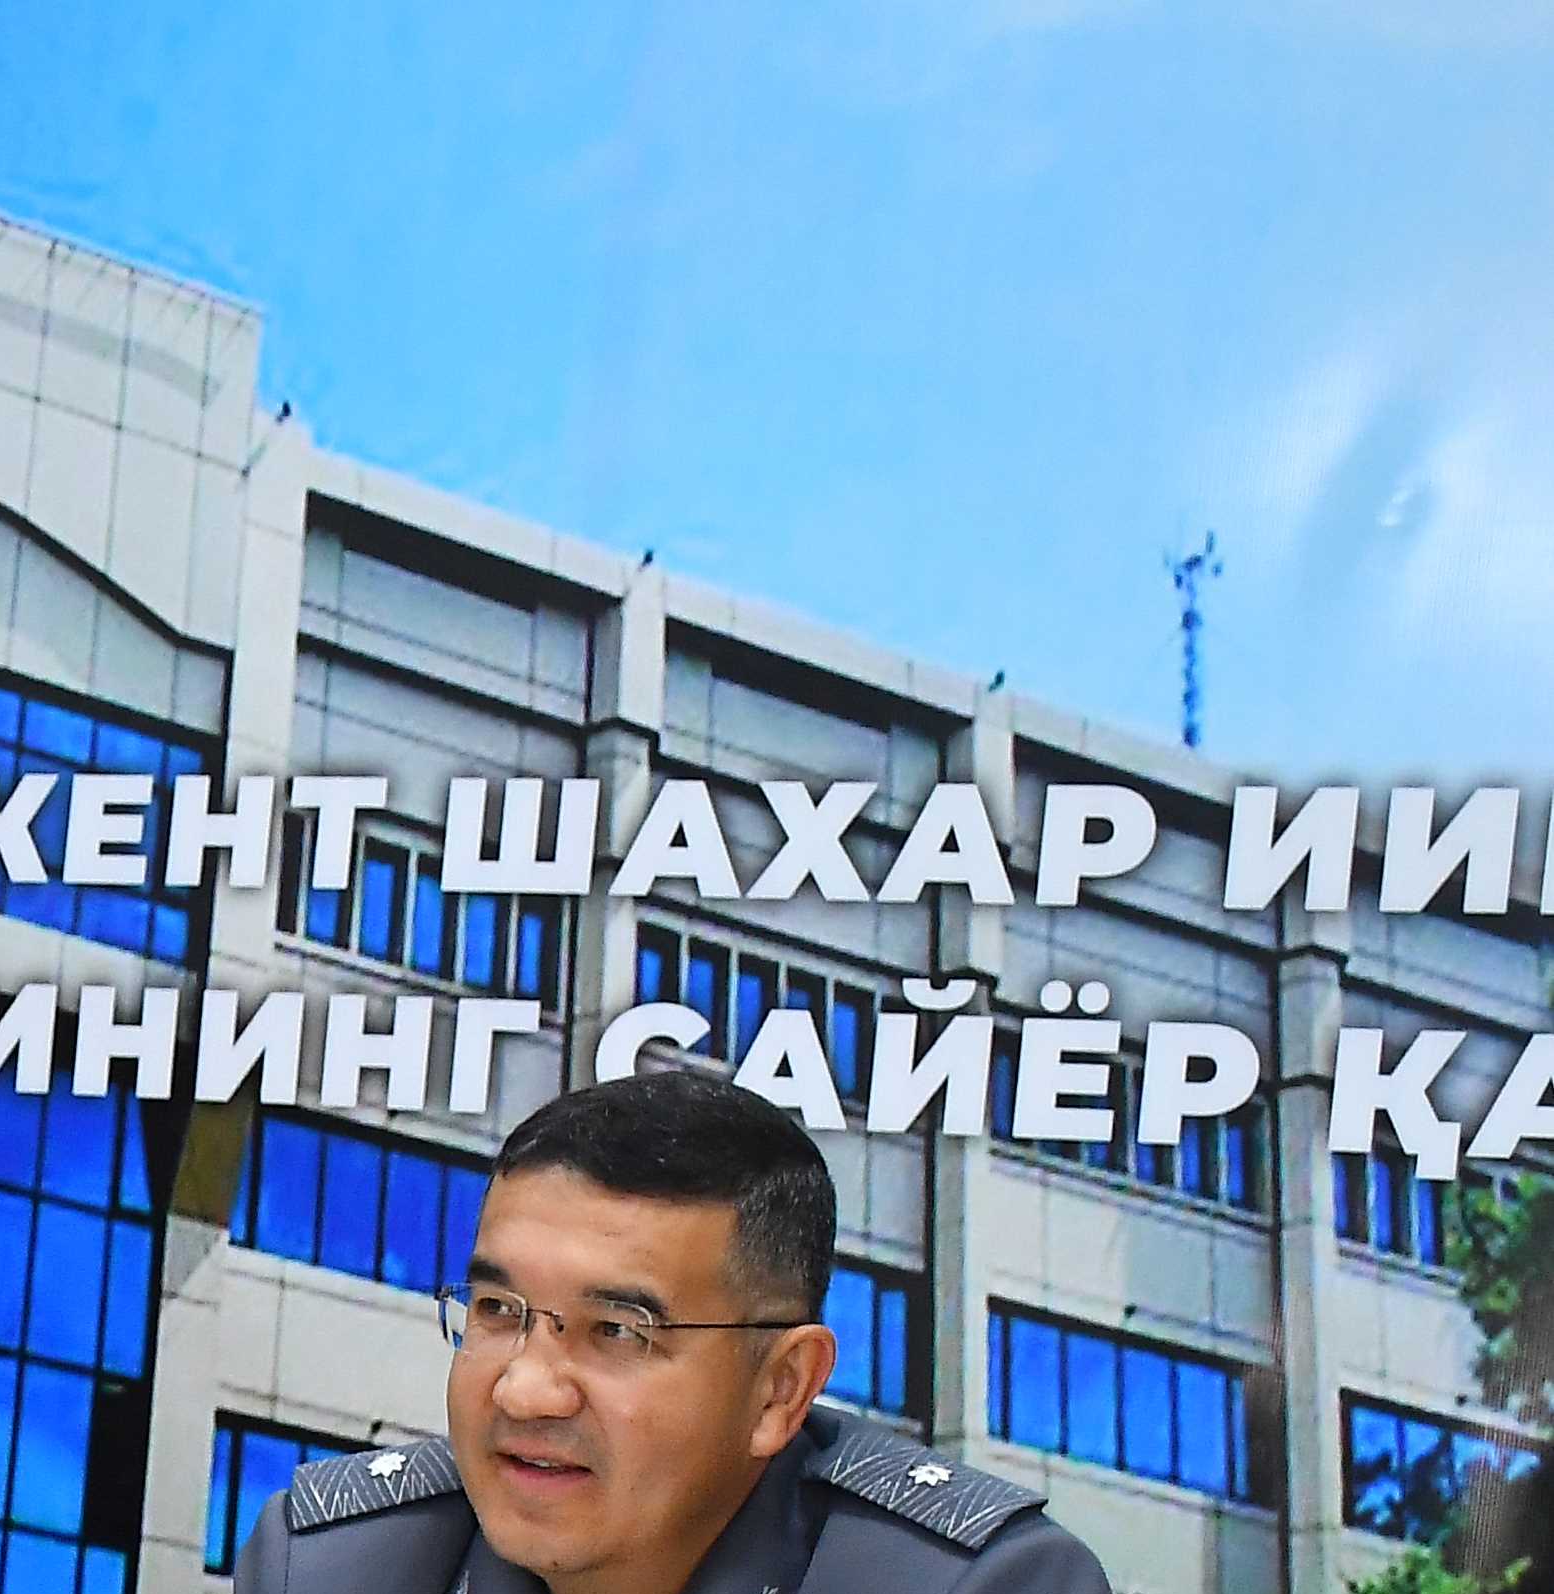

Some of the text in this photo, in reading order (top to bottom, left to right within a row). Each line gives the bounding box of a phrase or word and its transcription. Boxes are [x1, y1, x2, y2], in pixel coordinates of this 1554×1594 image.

[441, 777, 1158, 907] ШАХАР
[1223, 785, 1554, 915] ИИ
[595, 978, 1261, 1146] САЙЁР
